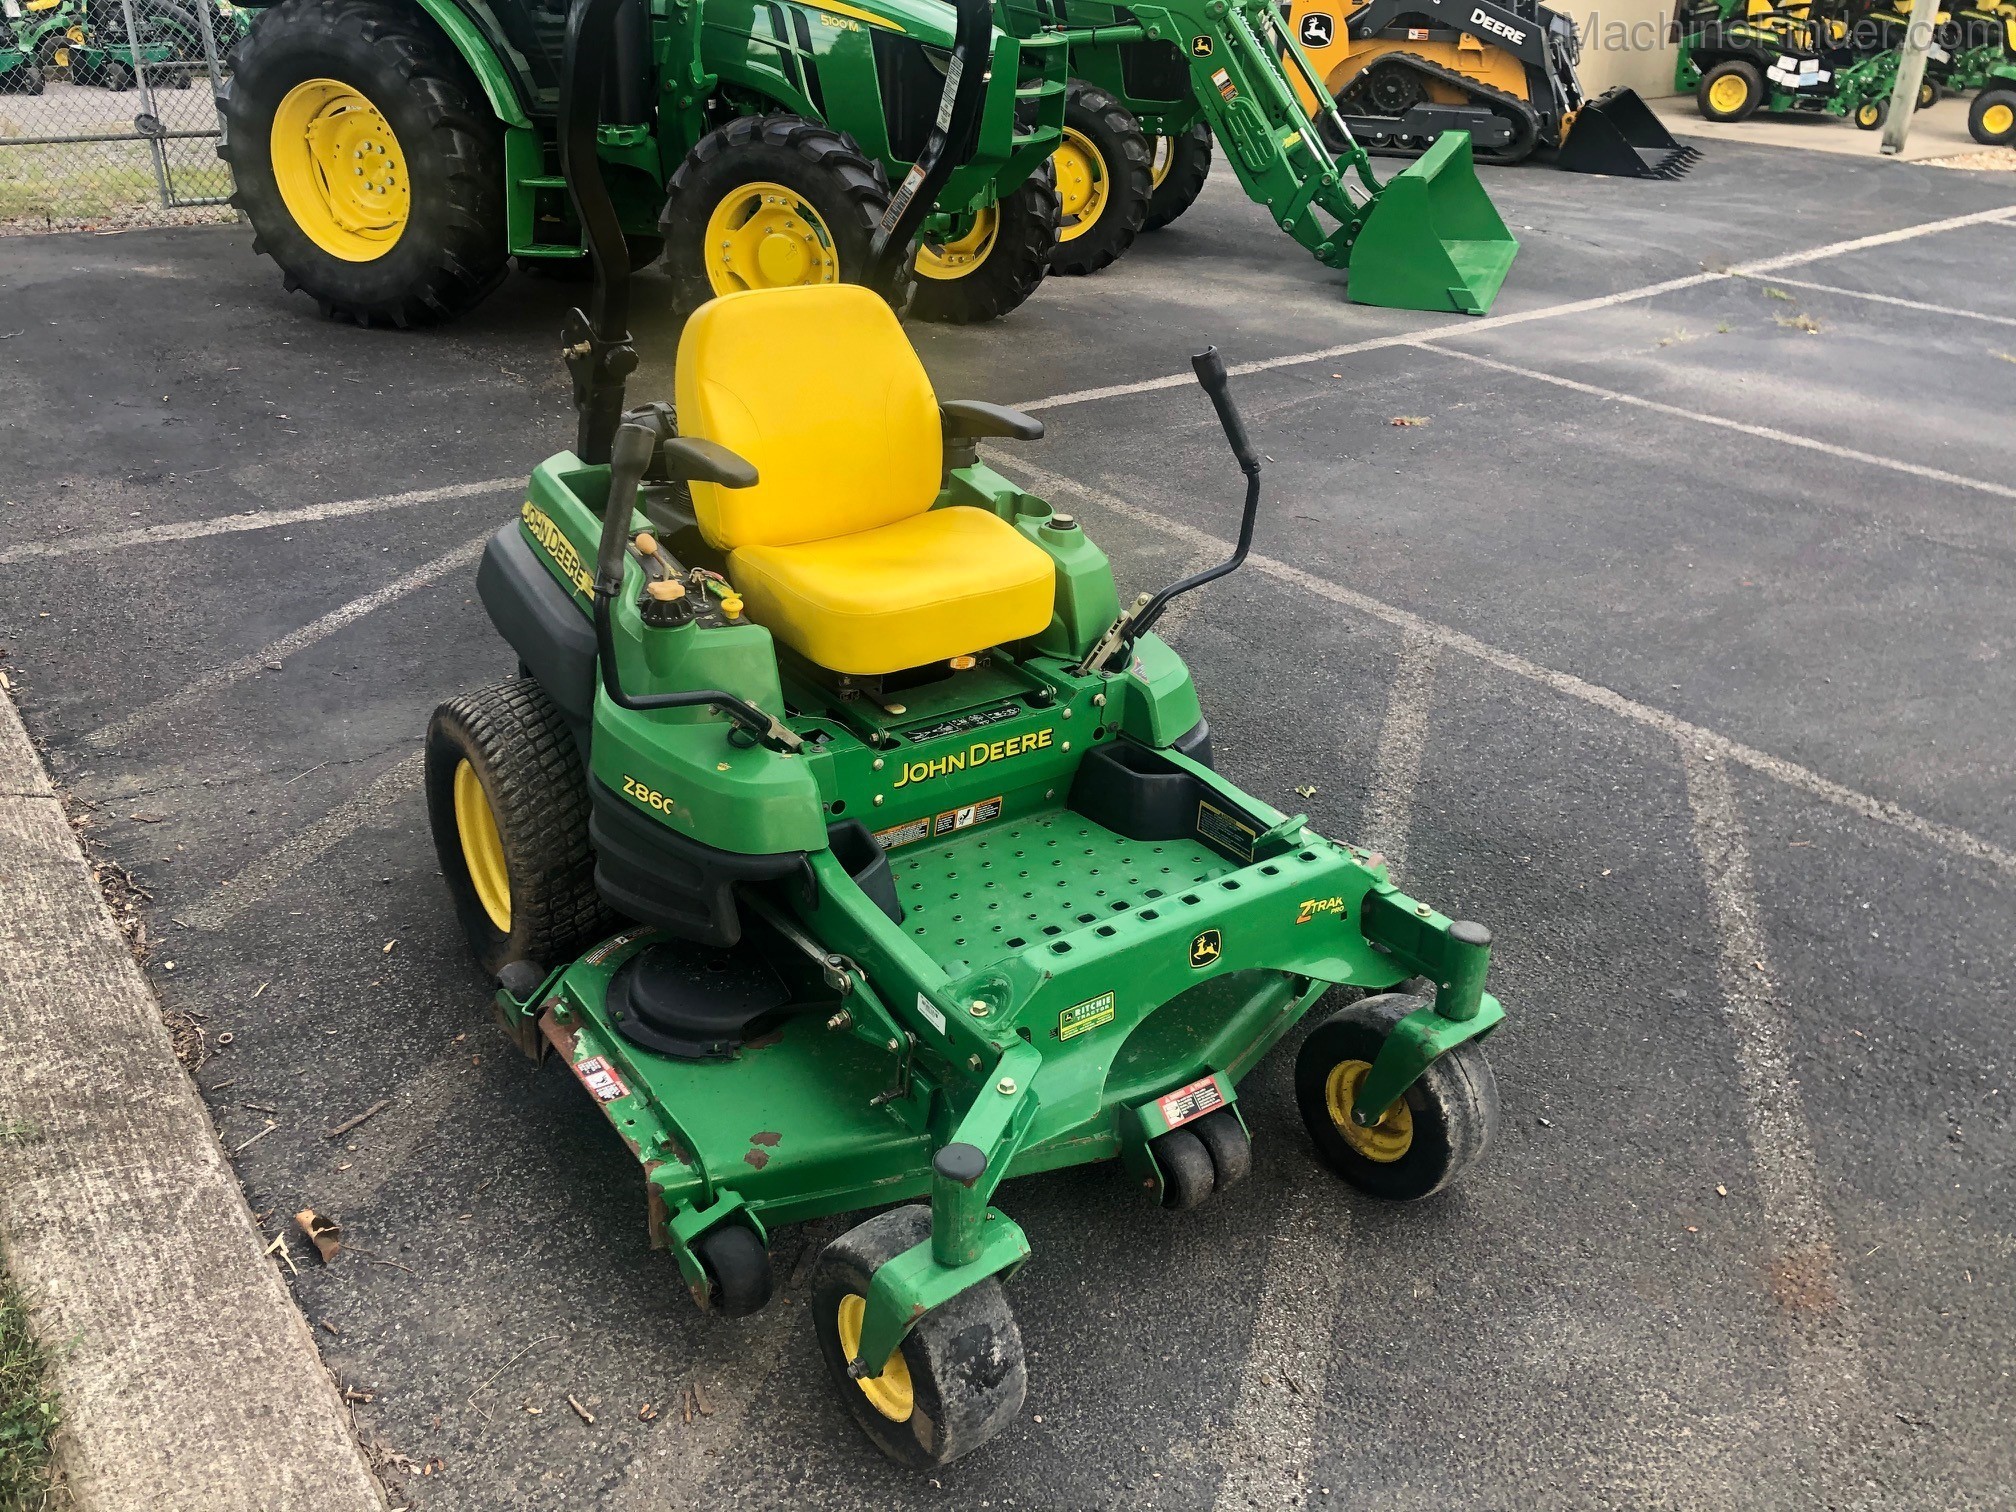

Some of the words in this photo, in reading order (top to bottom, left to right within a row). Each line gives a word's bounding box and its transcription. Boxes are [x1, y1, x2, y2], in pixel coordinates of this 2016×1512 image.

[820, 14, 859, 33] 5100M
[1469, 7, 1527, 46] DEERE
[546, 527, 585, 590] DEERE
[893, 751, 967, 788] JOHN
[970, 728, 1054, 768] DEERE
[1330, 905, 1345, 914] PRO
[1074, 996, 1112, 1017] RITCHIE
[1076, 1004, 1110, 1021] TRACTOR
